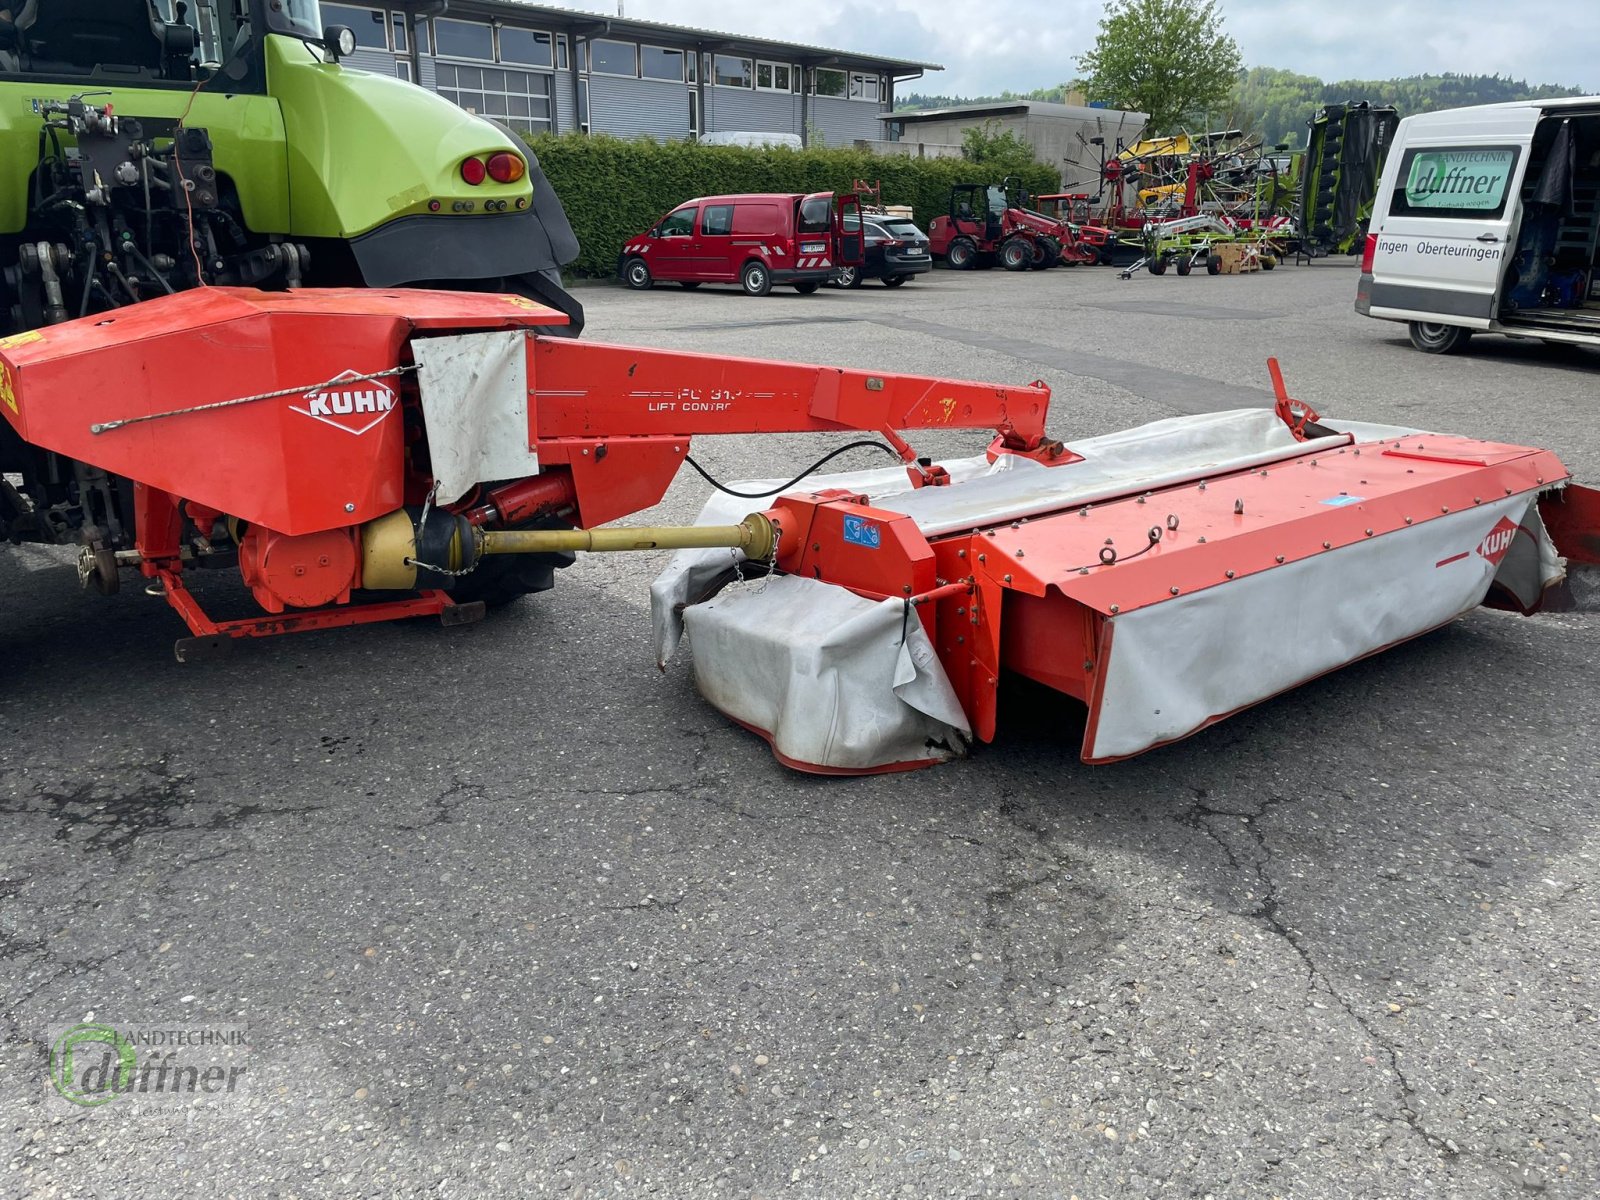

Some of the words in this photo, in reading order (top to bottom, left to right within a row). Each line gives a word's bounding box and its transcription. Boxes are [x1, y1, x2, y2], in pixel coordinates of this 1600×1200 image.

[1415, 166, 1501, 194] duffner
[1379, 239, 1408, 255] ingen
[1417, 241, 1500, 261] Oberteuringen
[309, 390, 392, 416] KUHN
[648, 402, 676, 411] LIFT
